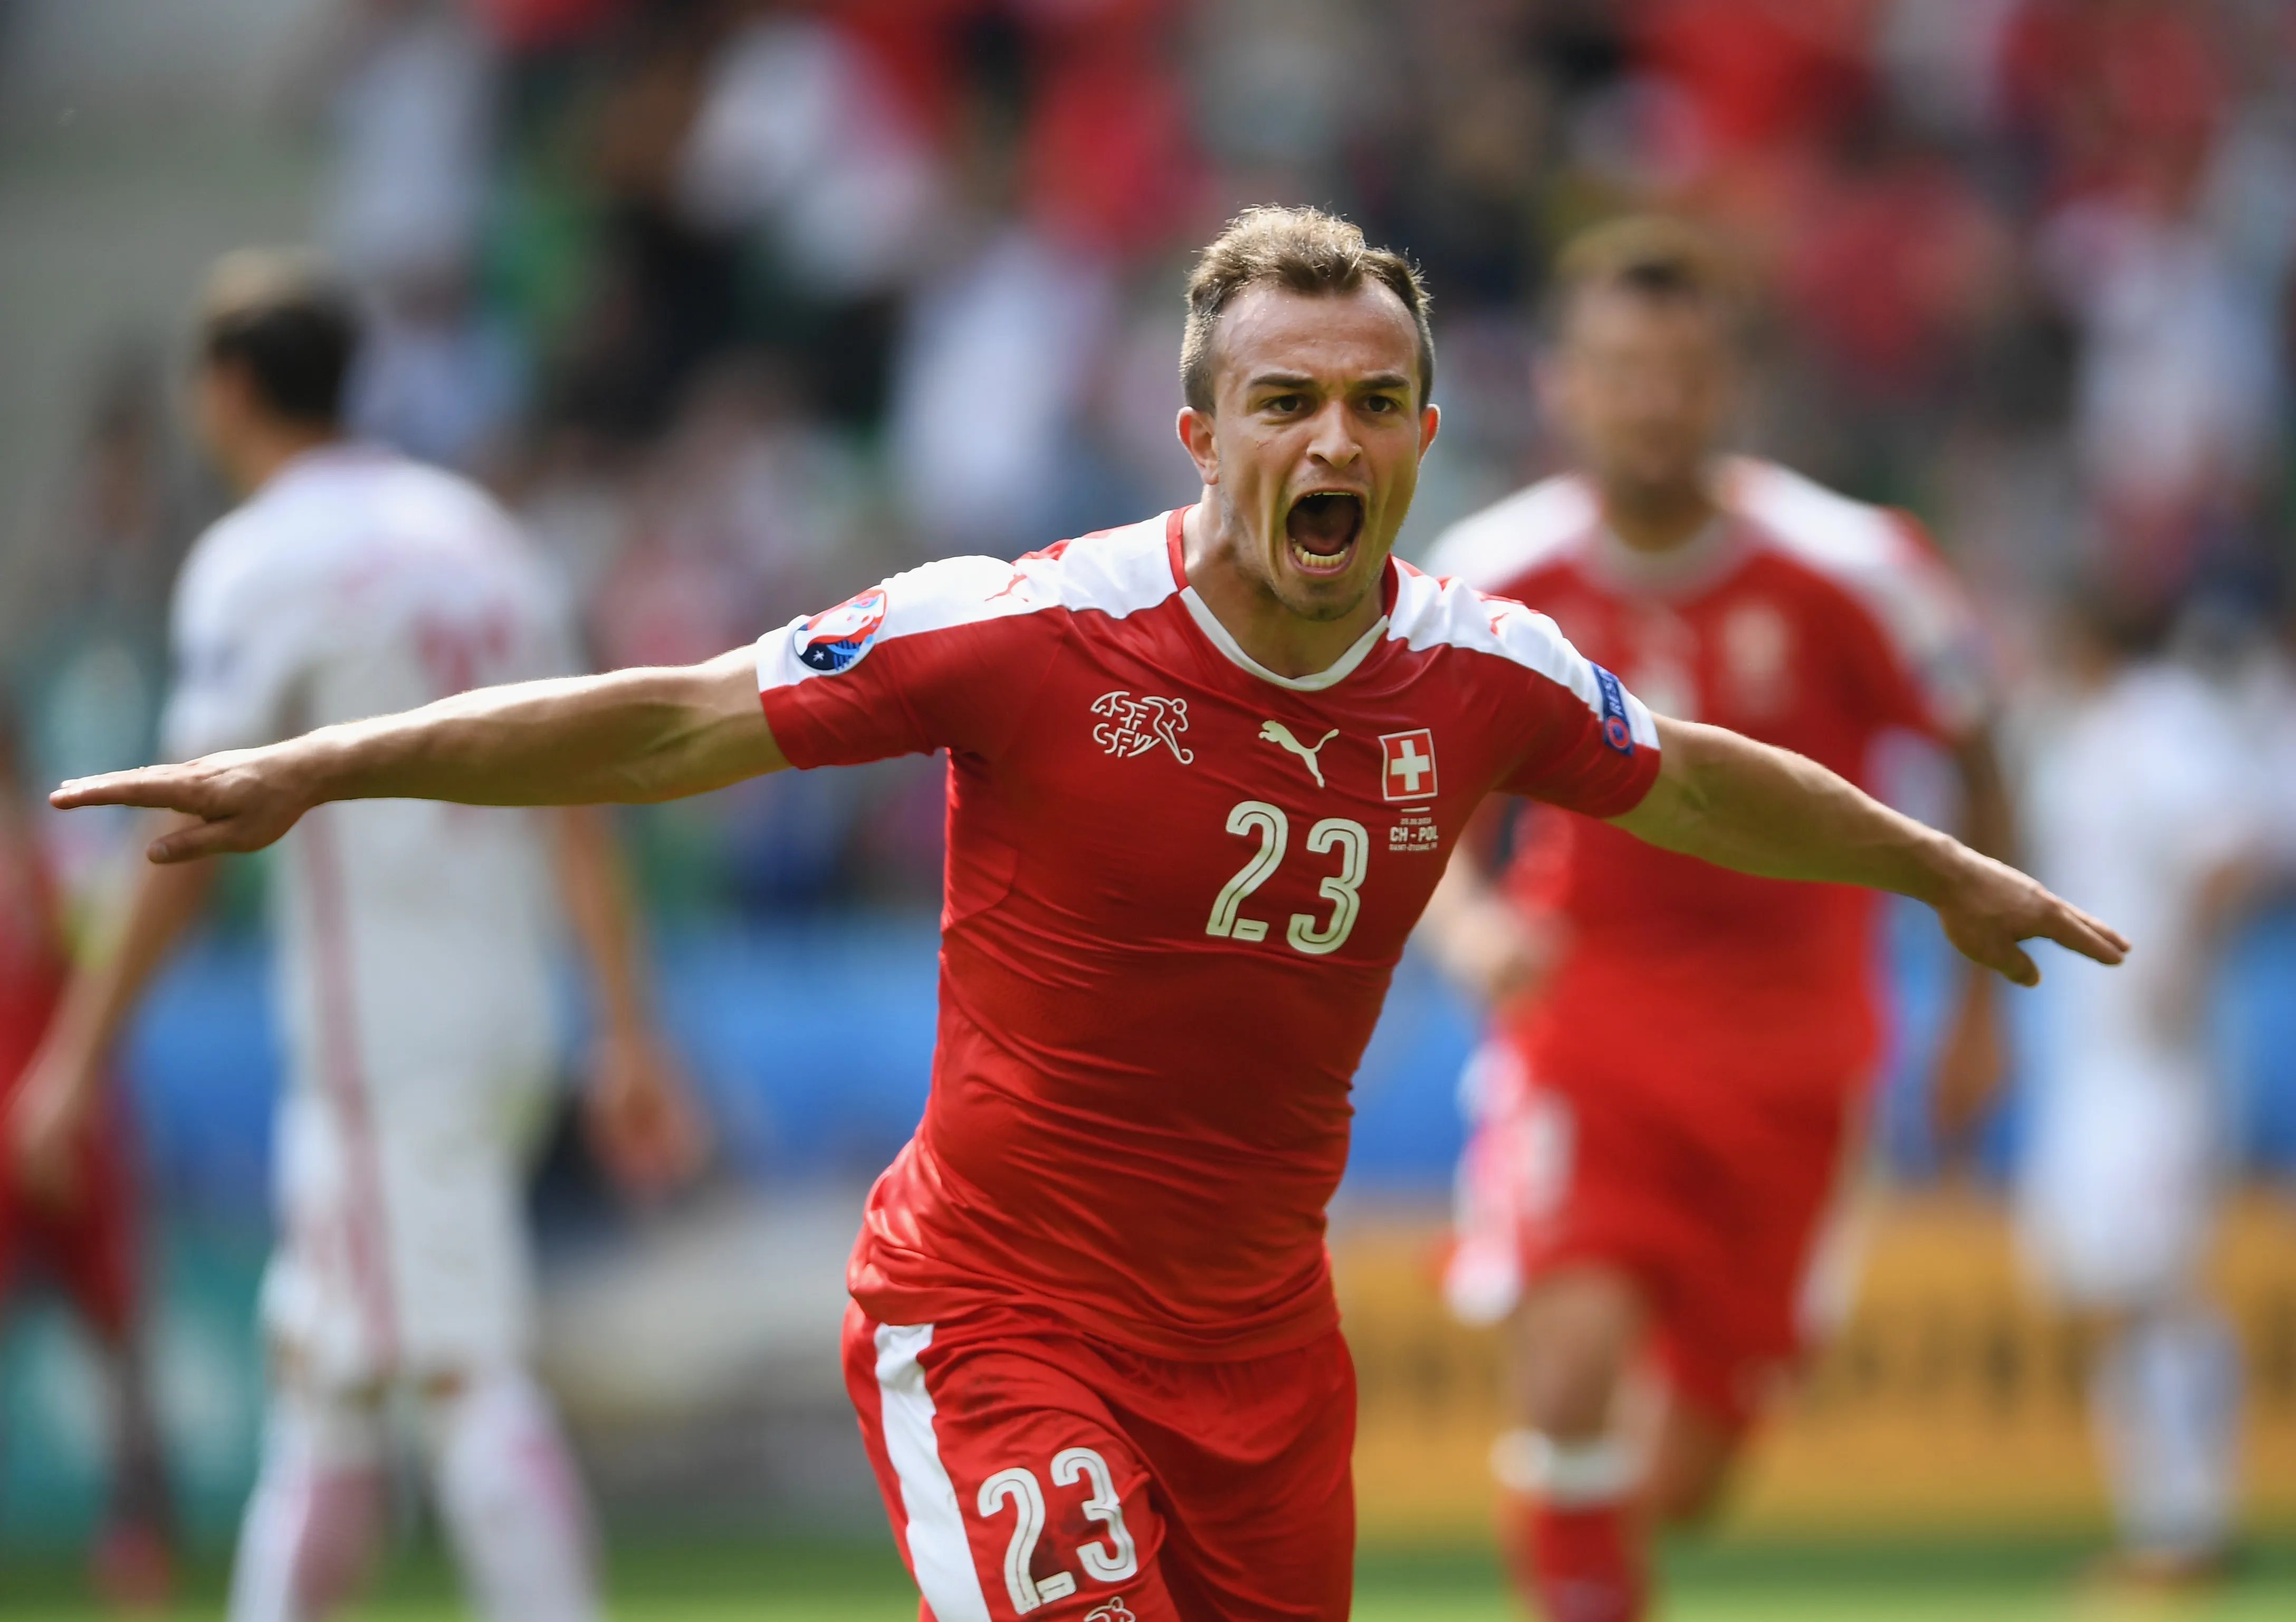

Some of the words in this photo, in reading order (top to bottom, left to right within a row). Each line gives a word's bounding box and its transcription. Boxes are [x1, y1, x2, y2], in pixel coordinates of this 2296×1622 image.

[1206, 800, 1370, 955] 23
[1390, 826, 1409, 842] CH
[1418, 825, 1439, 842] POL
[977, 1446, 1137, 1615] 23
